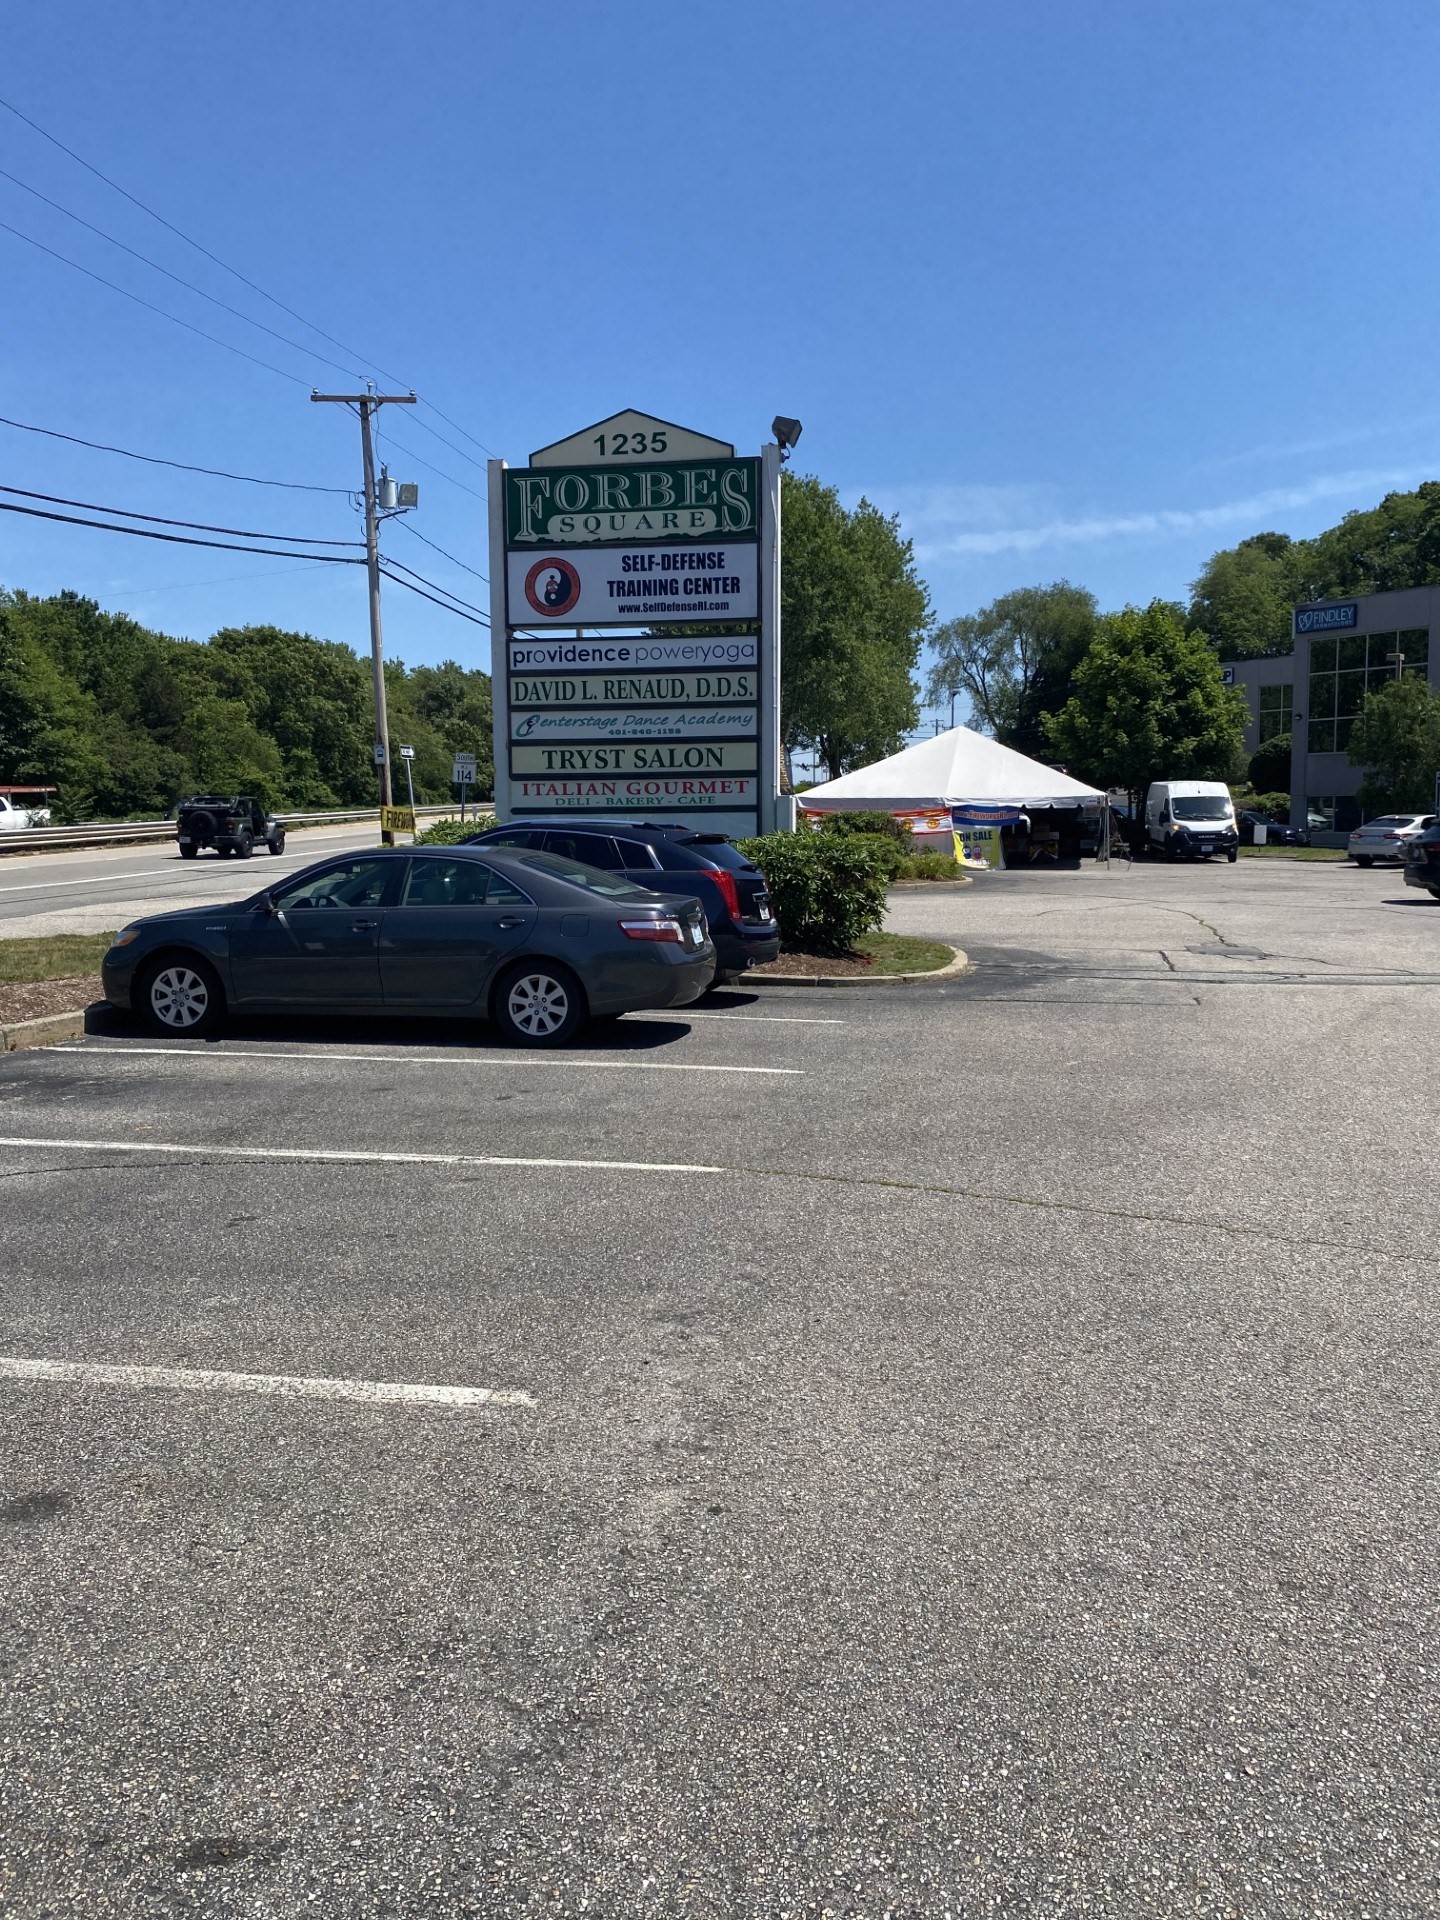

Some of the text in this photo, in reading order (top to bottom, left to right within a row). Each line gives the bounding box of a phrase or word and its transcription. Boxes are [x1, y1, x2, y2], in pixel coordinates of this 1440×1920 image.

[594, 432, 667, 456] 1235
[513, 468, 750, 541] FORBES
[559, 511, 706, 534] SQUARE
[622, 552, 725, 573] SELF-DEFENSE
[607, 577, 741, 598] TRAINING CENTER
[618, 601, 729, 613] www.SelfDefenseRI.com
[1313, 607, 1354, 623] FINDLEY
[513, 644, 754, 667] providence poweryoga
[514, 676, 753, 702] DAVID L. RENAUD, D.D.S.
[515, 711, 753, 737] Centerstage Dance Academy
[456, 753, 475, 761] SOUTH
[542, 747, 724, 769] TRYST SALON
[456, 770, 472, 782] 114
[522, 780, 749, 796] ITALIAN GOURMET
[555, 798, 590, 806] DELI
[606, 796, 664, 806] BAKERY
[677, 795, 716, 805] CAFE
[959, 830, 993, 842] ON SALE
